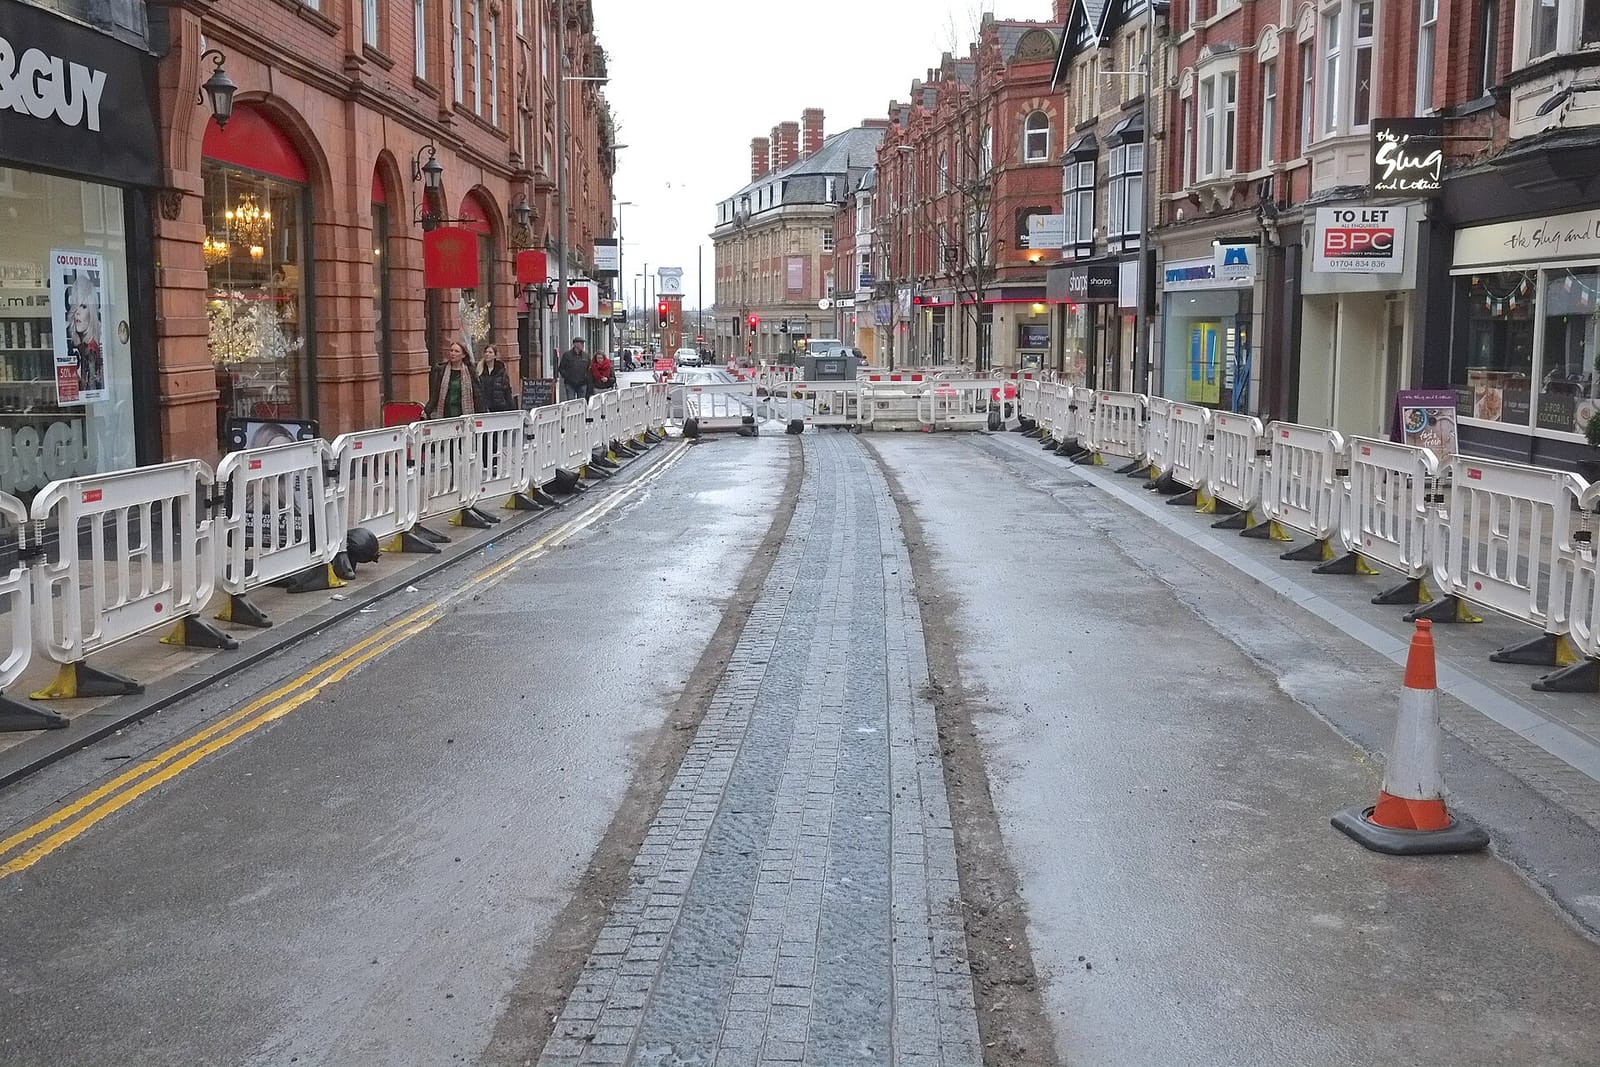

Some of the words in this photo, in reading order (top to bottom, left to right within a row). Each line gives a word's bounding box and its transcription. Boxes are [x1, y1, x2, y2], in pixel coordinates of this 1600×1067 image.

[1376, 127, 1400, 142] the
[1375, 134, 1443, 182] Slug
[1375, 177, 1397, 190] and
[1333, 210, 1356, 222] TO
[1361, 210, 1389, 223] LET
[1326, 232, 1393, 250] BPC
[1532, 221, 1561, 253] Slug
[1564, 219, 1591, 242] and
[56, 255, 83, 266] COLOUR
[83, 257, 98, 267] SALE
[1069, 271, 1088, 296] sharps
[1089, 277, 1112, 286] sharps
[1539, 414, 1570, 425] COCKTAILS
